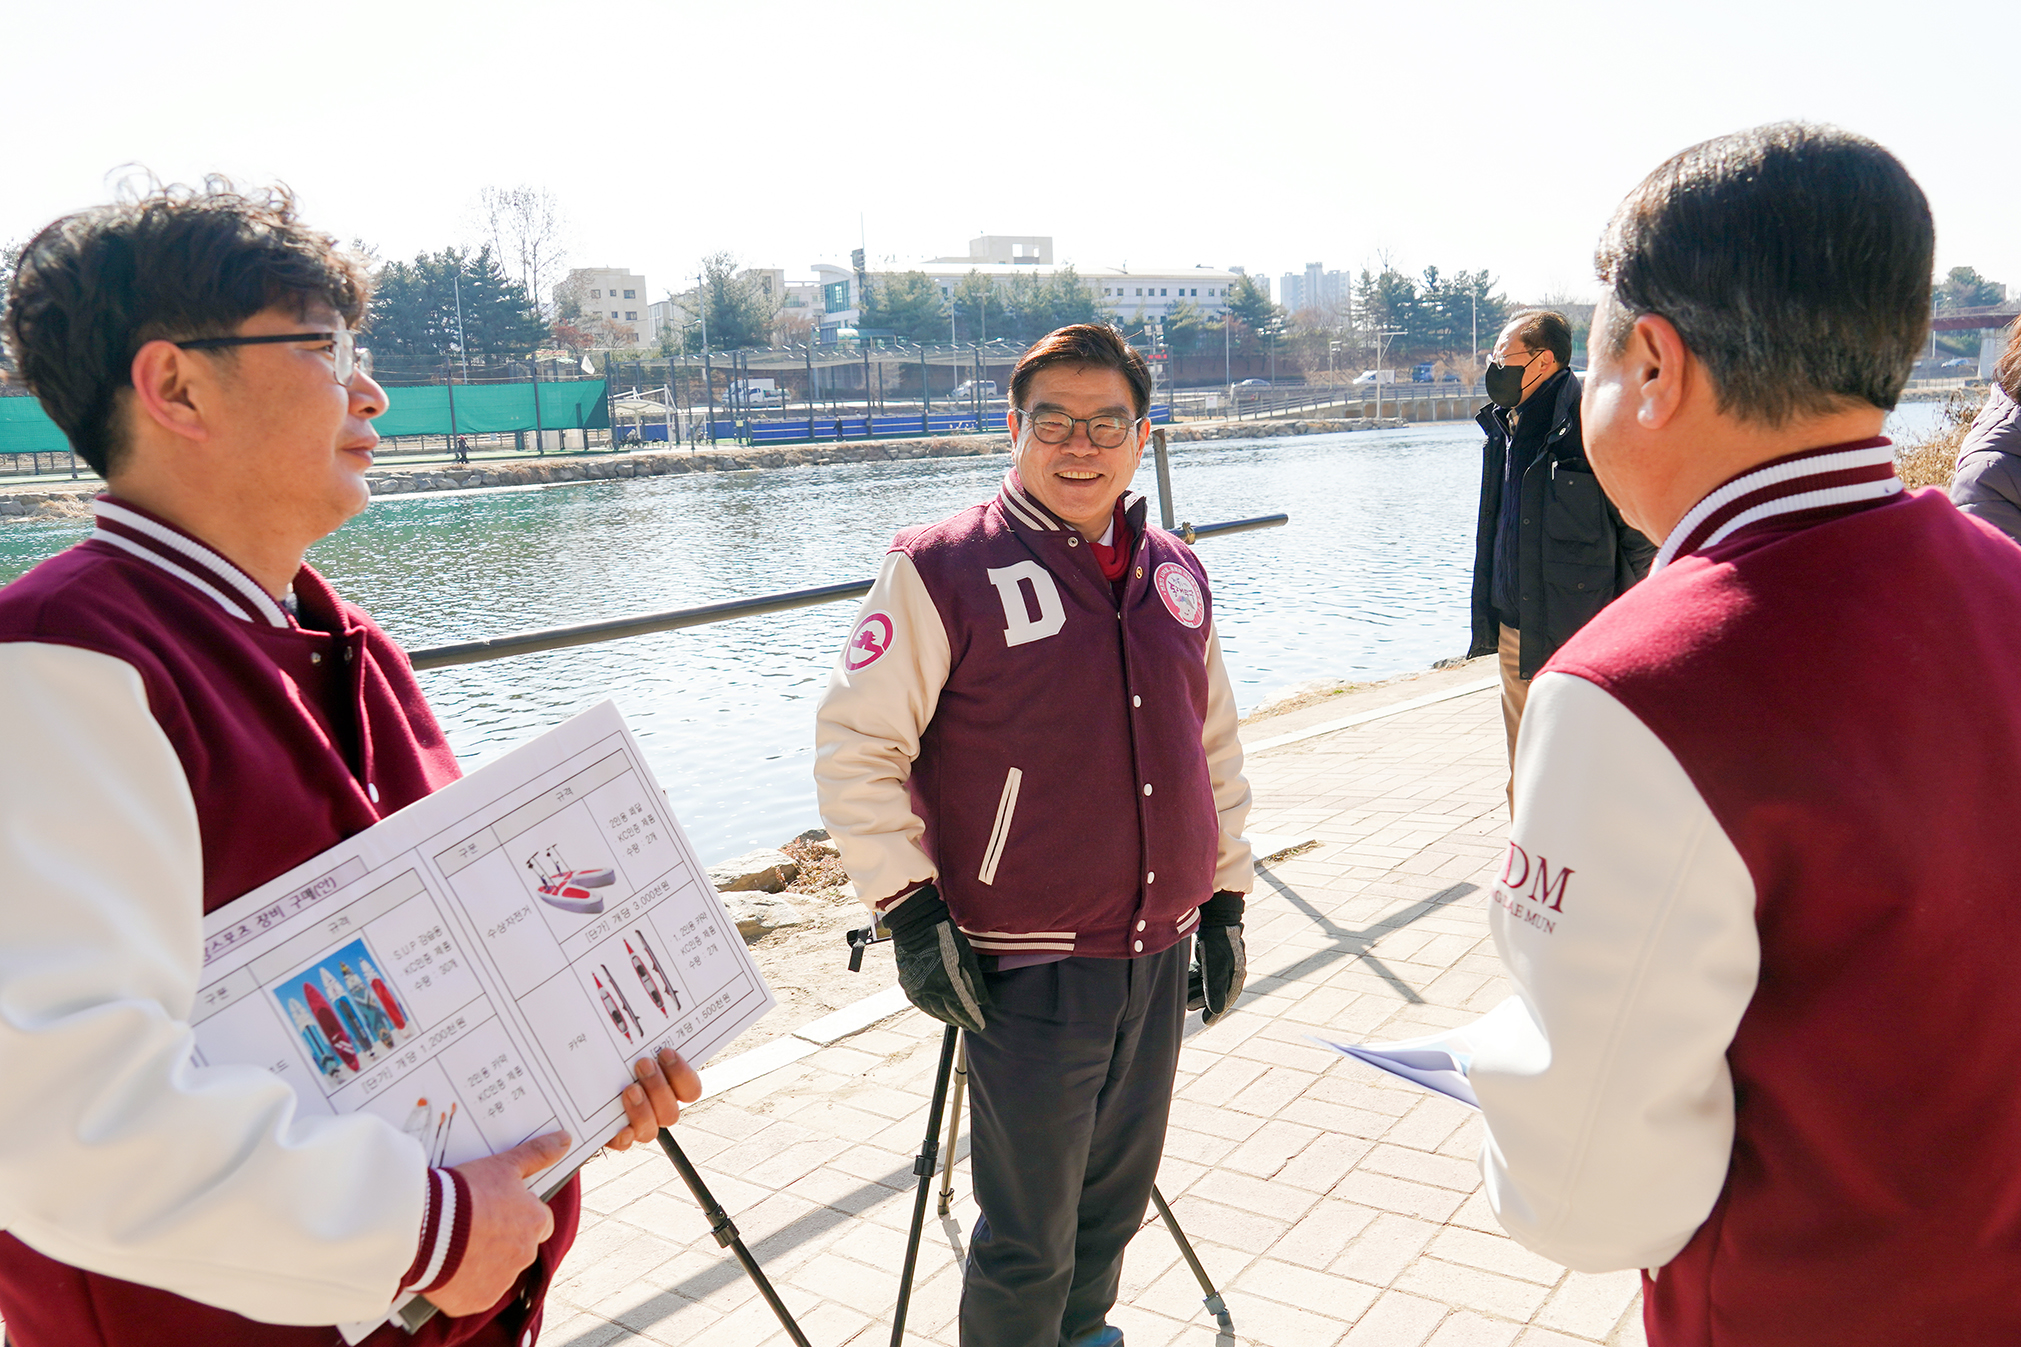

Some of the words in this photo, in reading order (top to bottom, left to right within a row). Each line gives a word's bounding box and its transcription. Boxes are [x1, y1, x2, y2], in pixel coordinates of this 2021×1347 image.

[987, 560, 1067, 647] D
[555, 787, 574, 802] 규격
[608, 812, 629, 829] 2인용
[617, 823, 641, 843] KC인증
[640, 813, 656, 828] 제품
[458, 843, 478, 858] 구분
[626, 843, 641, 857] 수량
[645, 832, 658, 845] 2개
[1501, 840, 1576, 914] DM
[256, 905, 286, 928] 장비
[289, 876, 337, 909] 구매(안)
[584, 920, 611, 943] [단가]
[612, 907, 631, 924] 개당
[632, 879, 671, 911] 3,000천원
[328, 916, 351, 934] 규격
[487, 905, 532, 939] 수상자전거
[679, 921, 696, 937] 2인용
[695, 911, 709, 925] 카약
[1524, 909, 1557, 935] MUN
[680, 937, 703, 956] KC인증
[702, 924, 717, 940] 제품
[688, 955, 702, 970] 수량
[706, 943, 719, 957] 2개
[204, 987, 230, 1005] 구분
[676, 1022, 694, 1038] 개당
[695, 992, 732, 1025] 1,500천원
[361, 1066, 393, 1094] [단가]
[395, 1051, 418, 1070] 개당
[420, 1016, 467, 1053] 1,200천원
[568, 1032, 588, 1052] 카약
